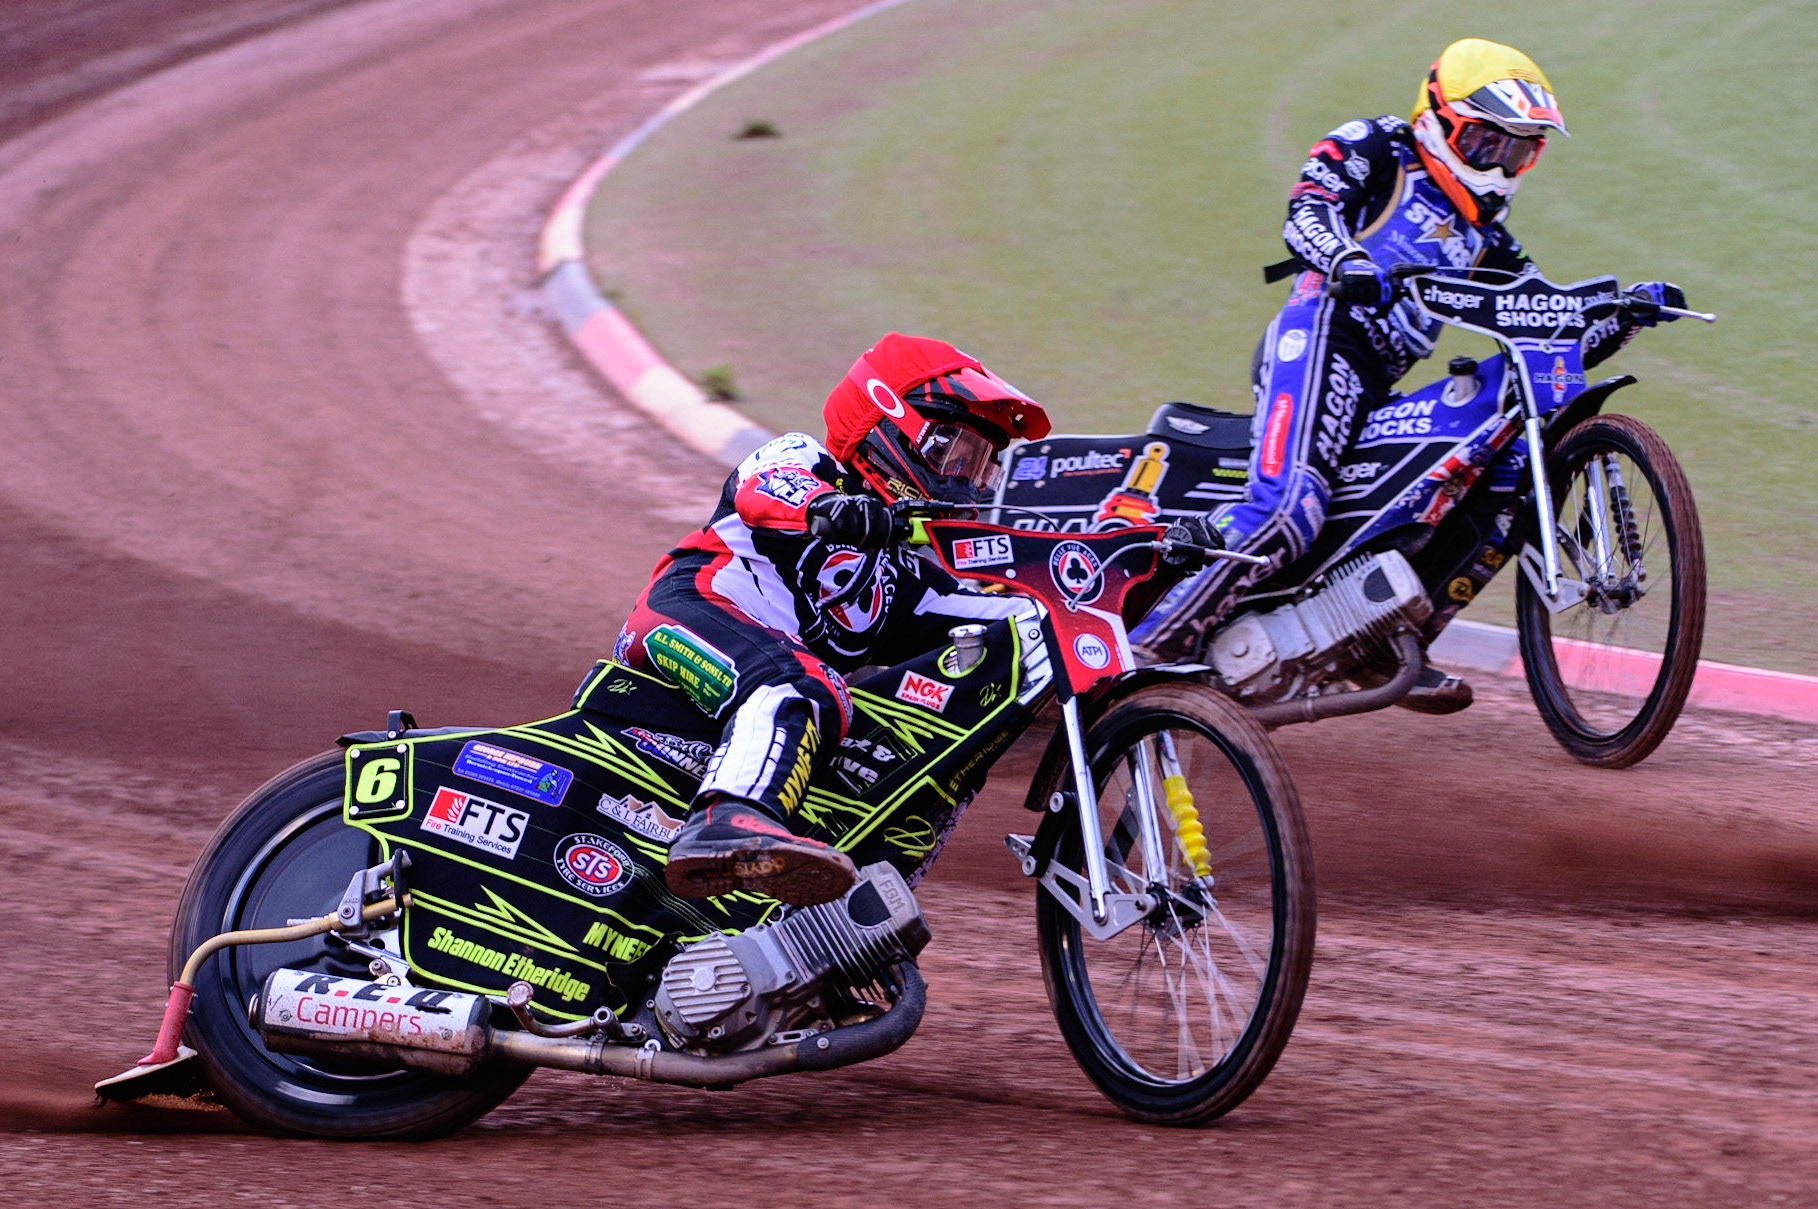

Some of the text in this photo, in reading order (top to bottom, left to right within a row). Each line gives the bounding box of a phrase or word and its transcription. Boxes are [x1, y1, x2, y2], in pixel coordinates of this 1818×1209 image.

[1495, 294, 1584, 312] HAGON
[1496, 312, 1586, 328] SHOCKS
[1535, 372, 1585, 385] HAGON
[1316, 353, 1350, 461] HAGON
[1050, 450, 1125, 478] poultec
[972, 537, 1009, 558] FTS
[668, 639, 697, 661] SMITH
[656, 653, 679, 673] SKIP
[679, 665, 701, 690] HIRE
[904, 675, 949, 703] NGK
[920, 698, 941, 710] PLUGS
[355, 757, 401, 804] 6
[459, 798, 526, 843] FTS
[600, 798, 610, 810] C
[612, 806, 622, 817] &
[623, 810, 634, 821] L
[426, 819, 511, 855] Fire Training Services
[572, 850, 613, 879] STS
[573, 835, 630, 869] STAKEFORD
[556, 857, 624, 894] TYRE SERVICES
[427, 925, 591, 1002] Shannon Etheridge
[297, 996, 423, 1036] Campers
